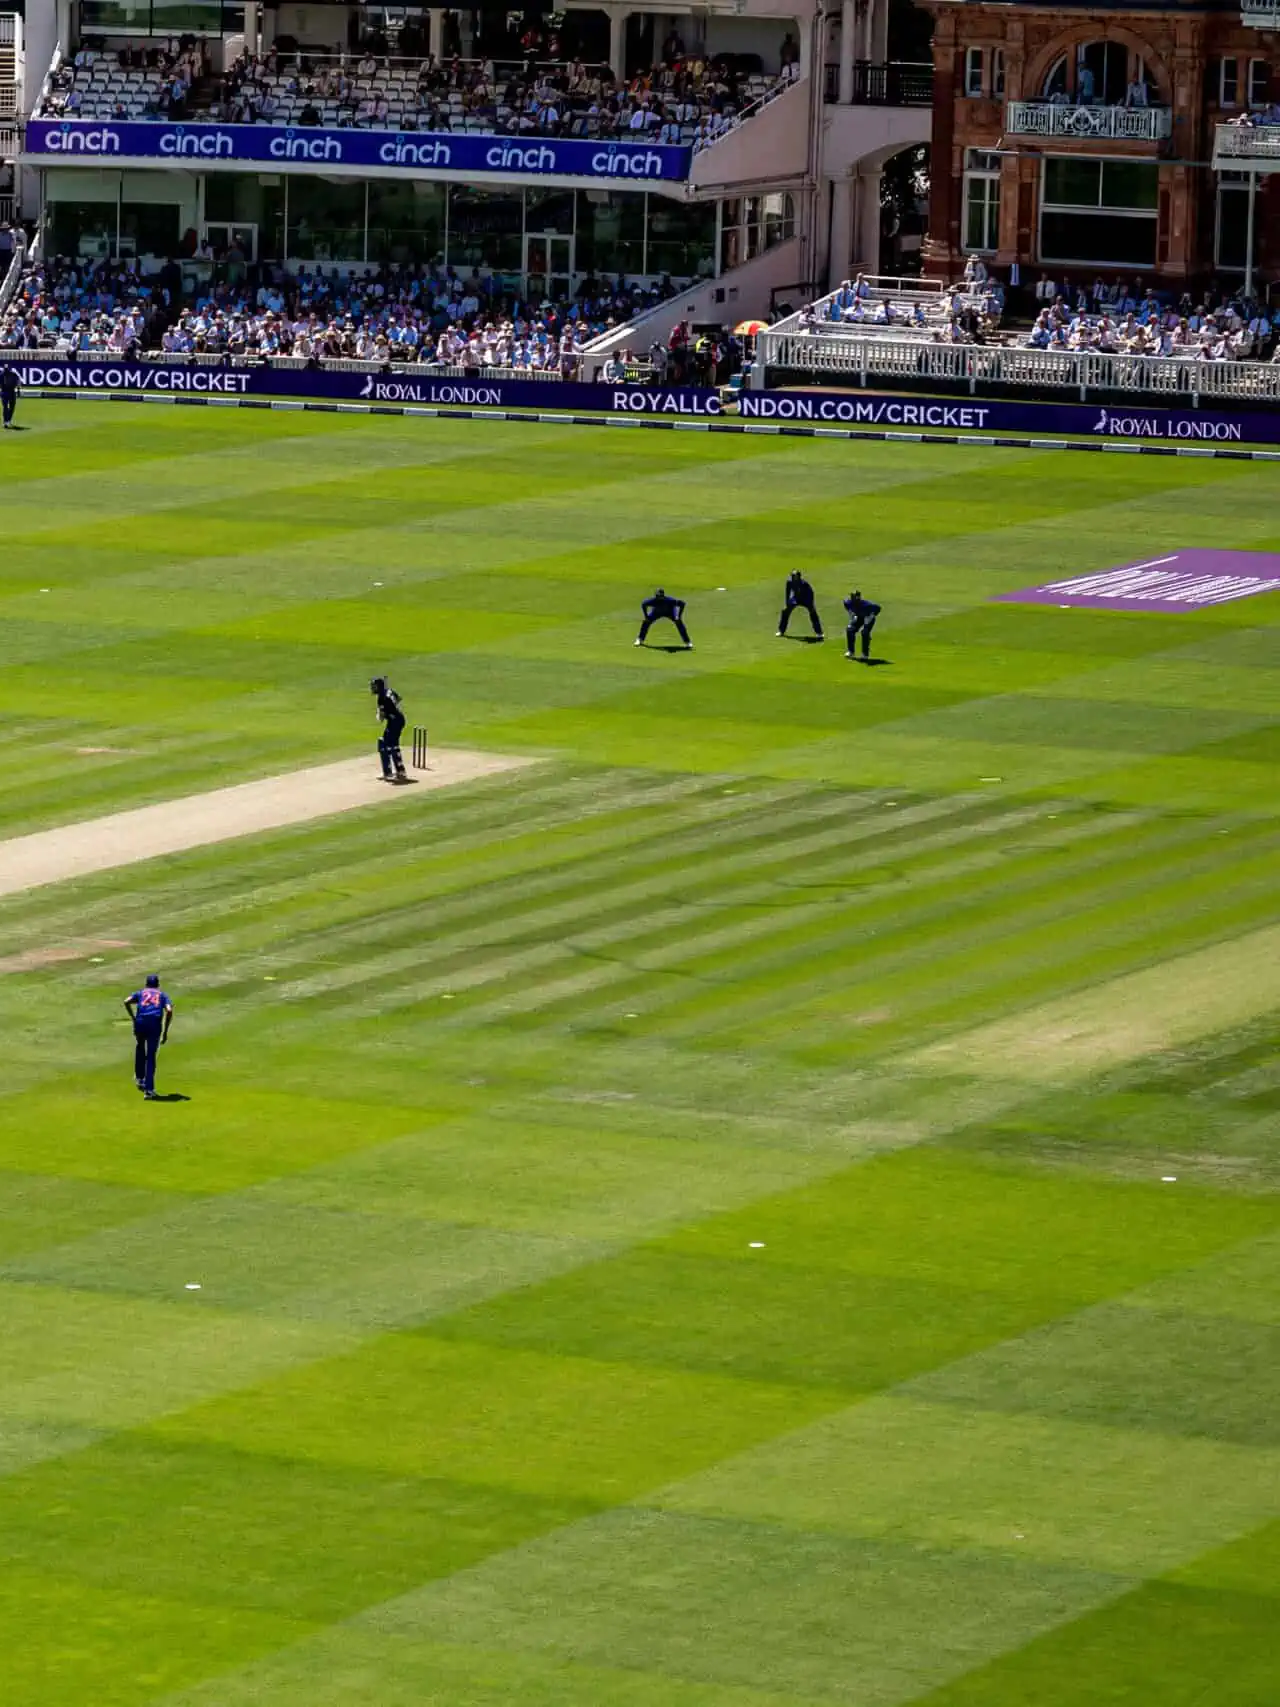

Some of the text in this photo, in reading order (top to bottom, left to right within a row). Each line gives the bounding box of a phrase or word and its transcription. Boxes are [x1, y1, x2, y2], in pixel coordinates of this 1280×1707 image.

[45, 123, 120, 154] cinch
[159, 127, 233, 157] cinch
[269, 129, 342, 161] cinch
[379, 135, 451, 166] cinch
[486, 139, 556, 170] cinch
[591, 144, 663, 176] cinch
[375, 382, 502, 406] ROYAL LONDON
[1109, 418, 1242, 442] ROYAL LONDON
